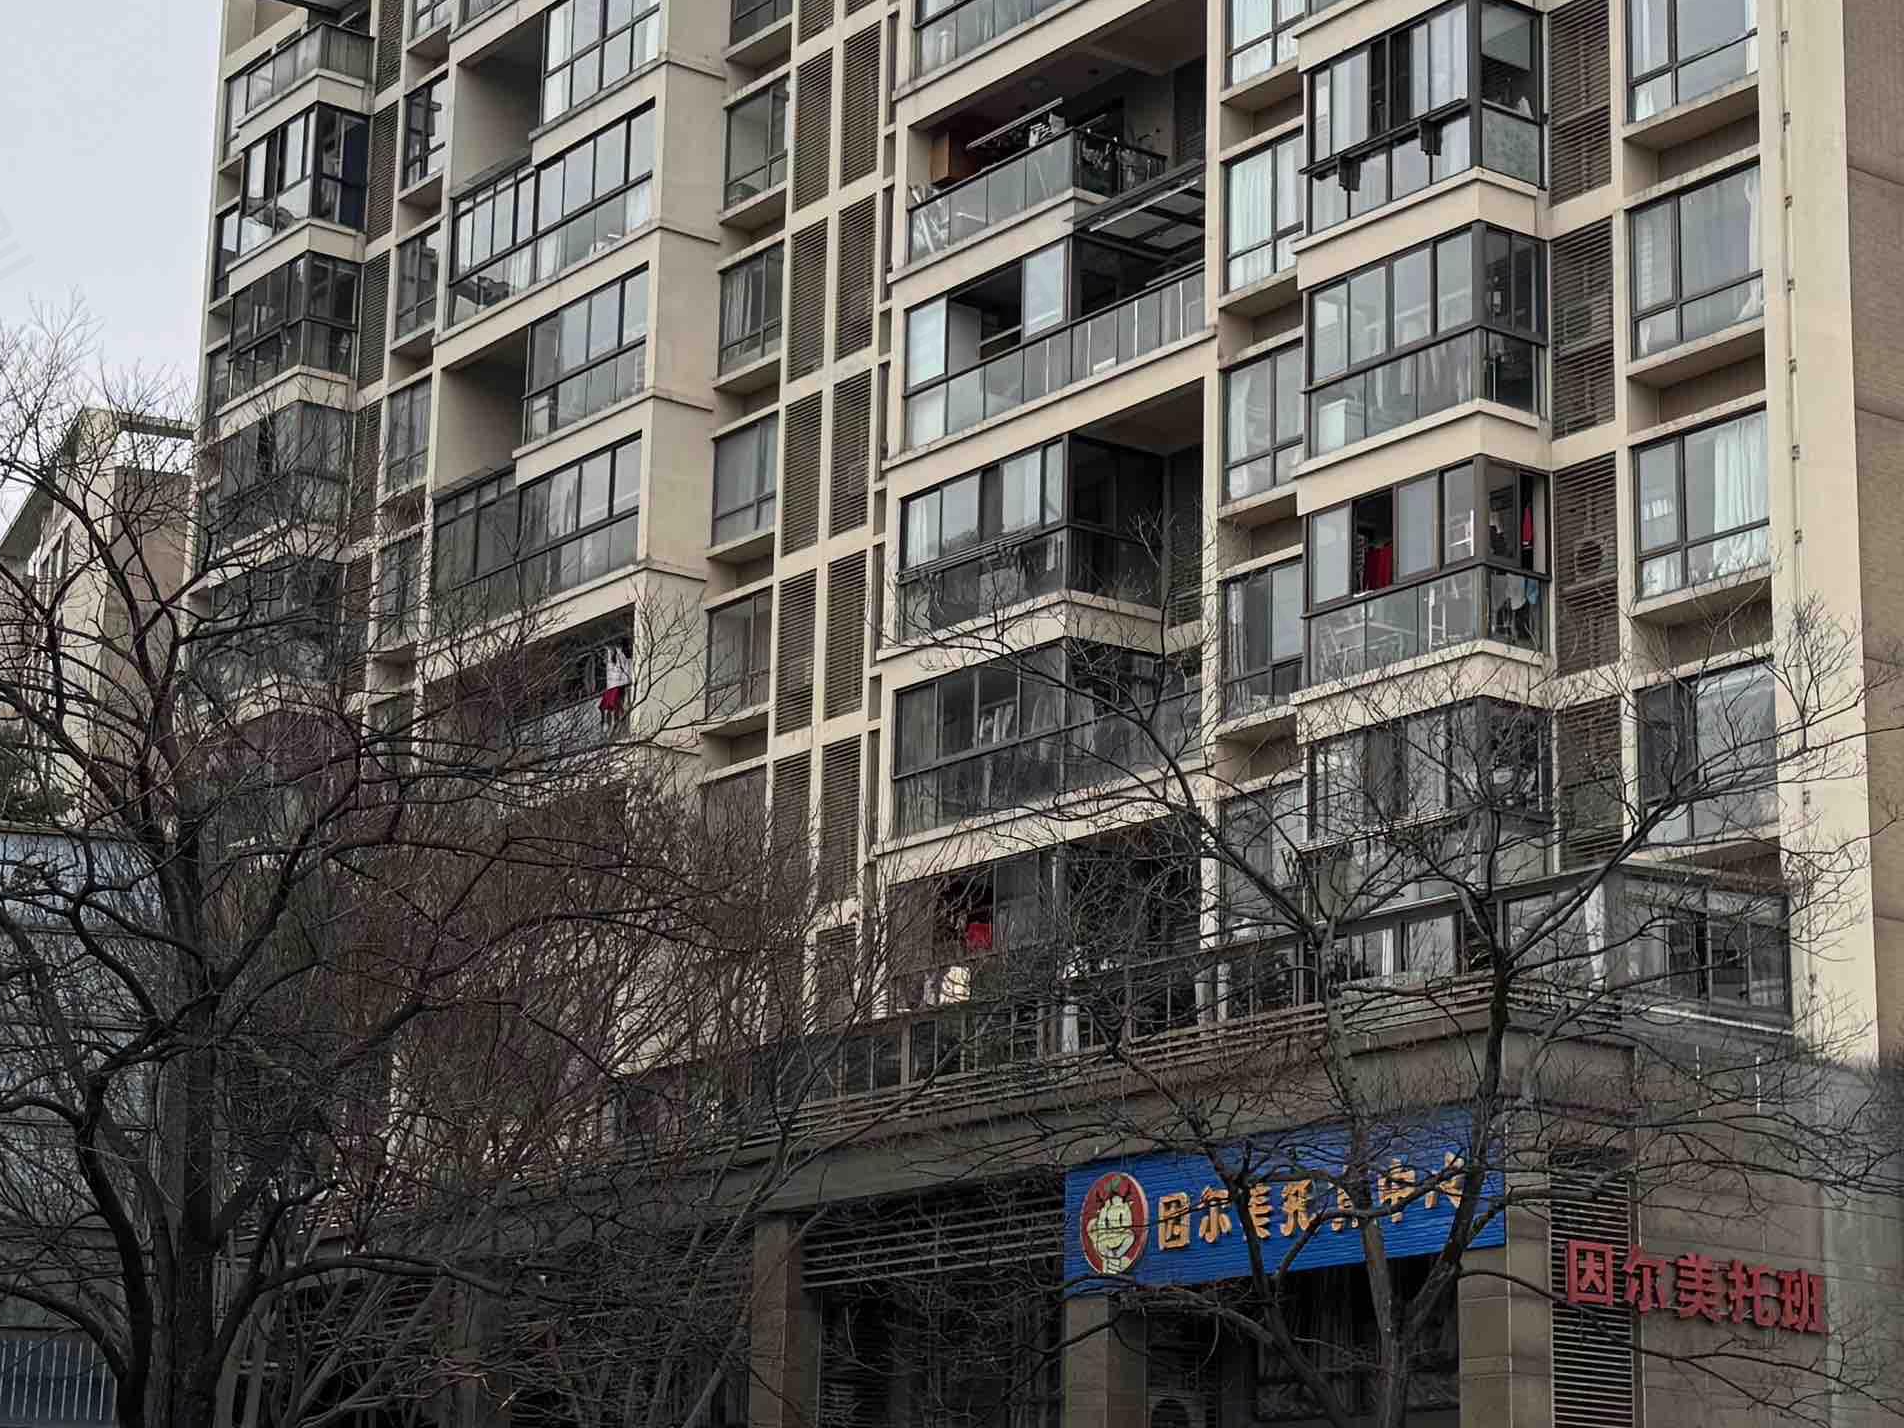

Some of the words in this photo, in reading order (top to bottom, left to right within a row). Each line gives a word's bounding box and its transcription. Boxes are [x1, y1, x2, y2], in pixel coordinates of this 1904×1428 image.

[1568, 1239, 1829, 1334] 因尔美托班
